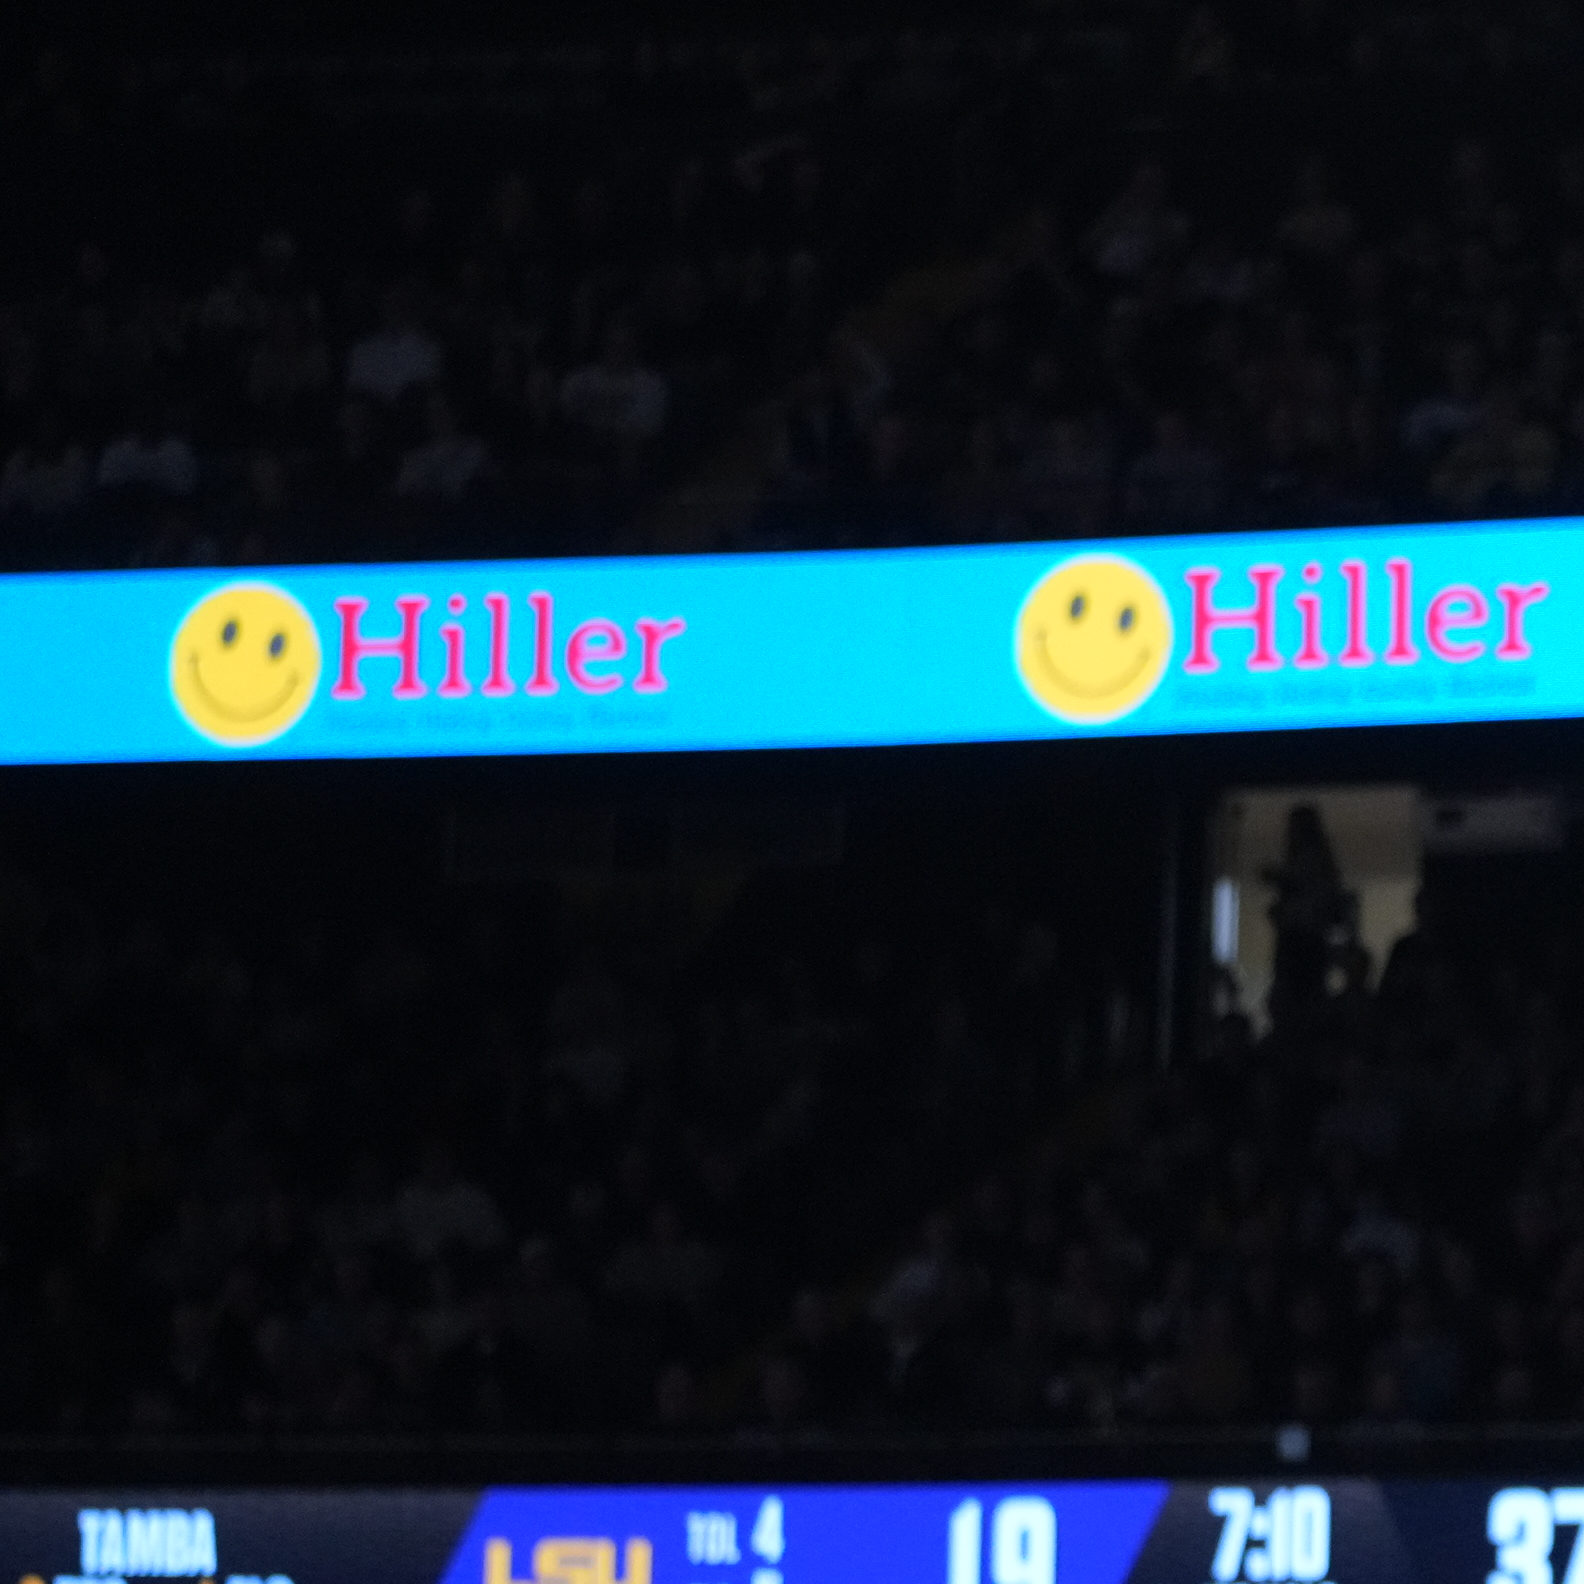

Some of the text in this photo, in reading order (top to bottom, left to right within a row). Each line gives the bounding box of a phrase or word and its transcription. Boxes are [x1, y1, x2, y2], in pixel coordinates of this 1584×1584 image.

[331, 593, 688, 699] Hiller
[1182, 558, 1551, 673] Hiller
[78, 1509, 217, 1577] TAMBA
[751, 1495, 785, 1565] 4
[1208, 1486, 1331, 1582] 7:10
